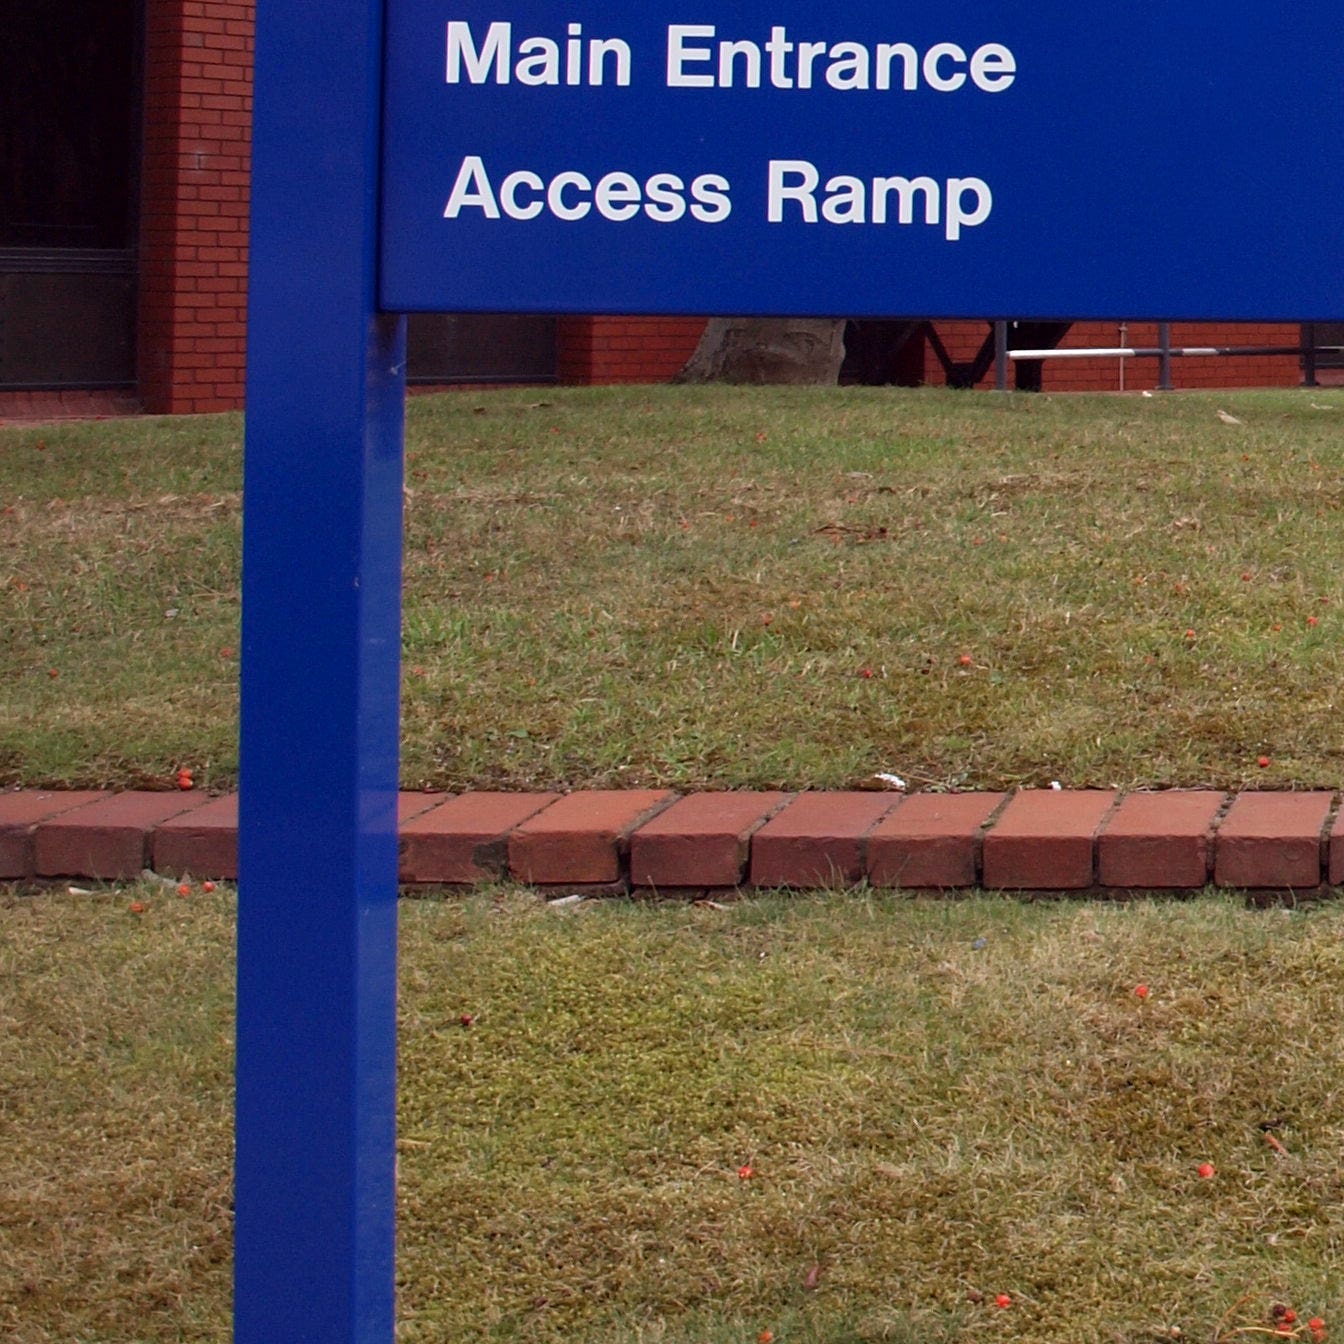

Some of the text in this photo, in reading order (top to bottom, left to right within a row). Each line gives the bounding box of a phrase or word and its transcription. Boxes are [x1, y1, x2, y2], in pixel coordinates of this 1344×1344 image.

[445, 20, 1016, 93] Main Entrance
[443, 154, 992, 241] Access Ramp
